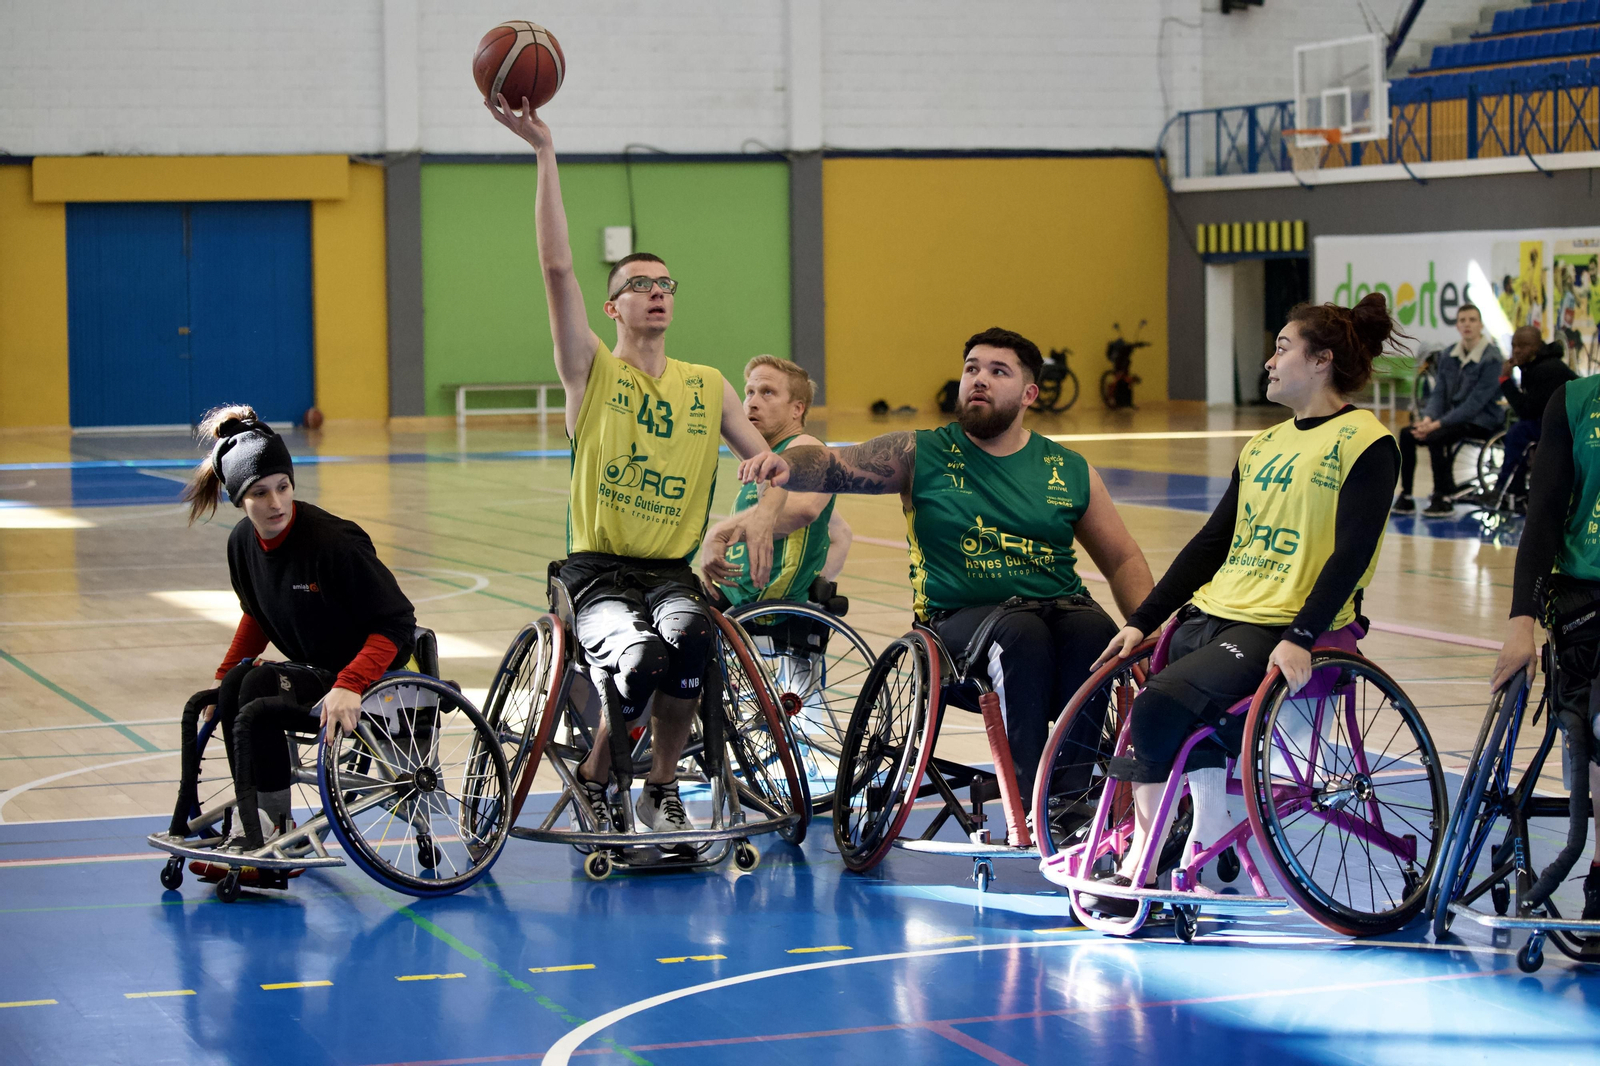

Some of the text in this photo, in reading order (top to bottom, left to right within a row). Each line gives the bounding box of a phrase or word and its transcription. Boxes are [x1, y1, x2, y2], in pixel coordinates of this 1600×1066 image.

[637, 393, 674, 438] 43
[1253, 453, 1301, 492] 44
[599, 482, 682, 518] Reyes Gutiérrez
[600, 499, 626, 514] rutas
[965, 557, 1002, 573] Reyes
[1240, 552, 1292, 574] Gutiérrez
[1219, 641, 1245, 660] vive
